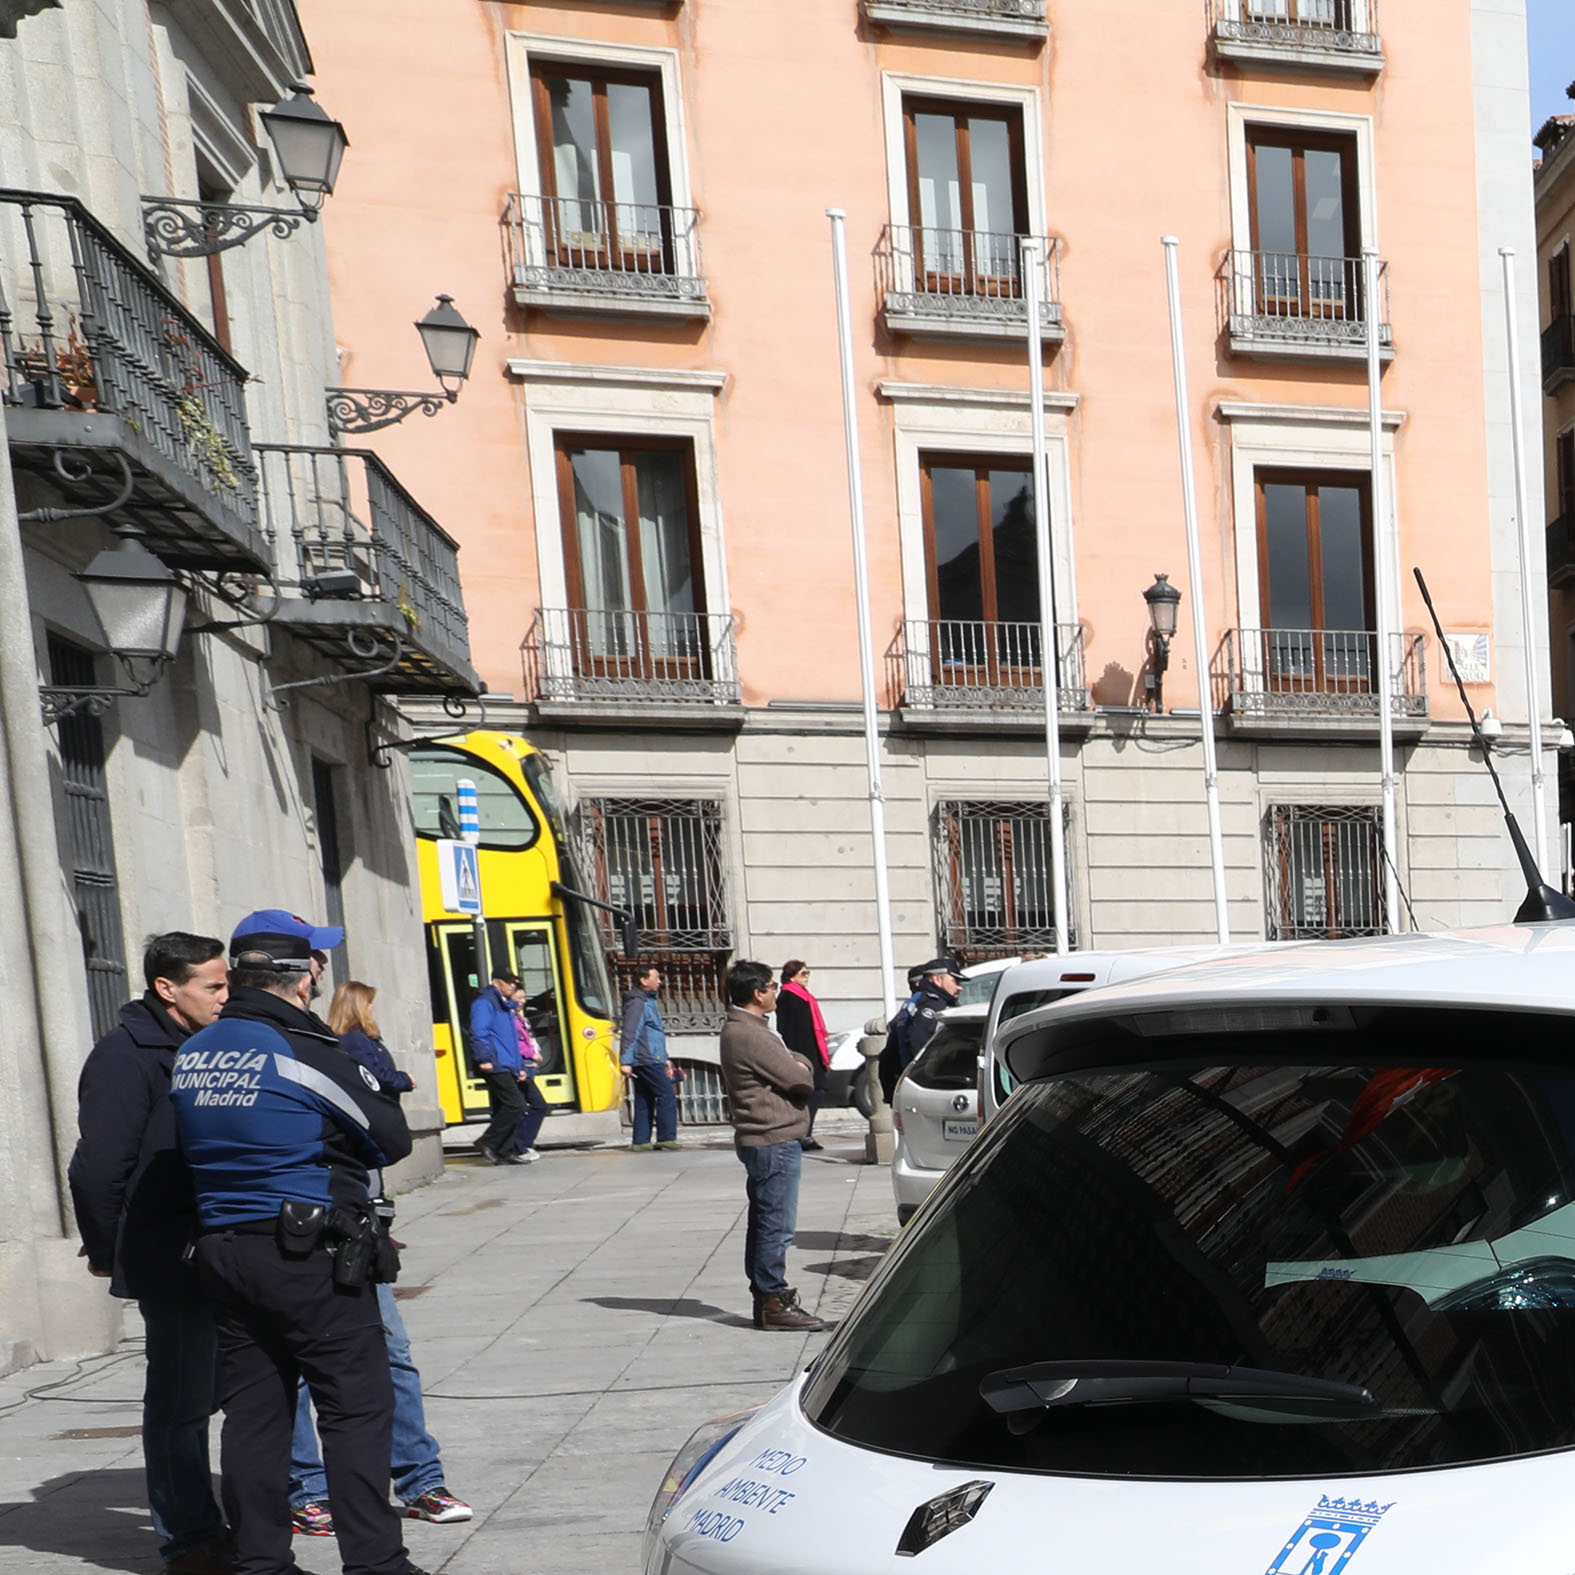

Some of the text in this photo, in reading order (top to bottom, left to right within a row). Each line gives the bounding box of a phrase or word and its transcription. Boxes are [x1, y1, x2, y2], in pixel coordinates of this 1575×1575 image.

[175, 1048, 268, 1070] POLICÍA
[171, 1072, 261, 1090] MUNICIPAL
[194, 1090, 258, 1107] Madrid
[749, 1447, 808, 1475] MEDIO
[713, 1477, 796, 1514] AMBIENTE
[683, 1508, 745, 1542] MADRID
